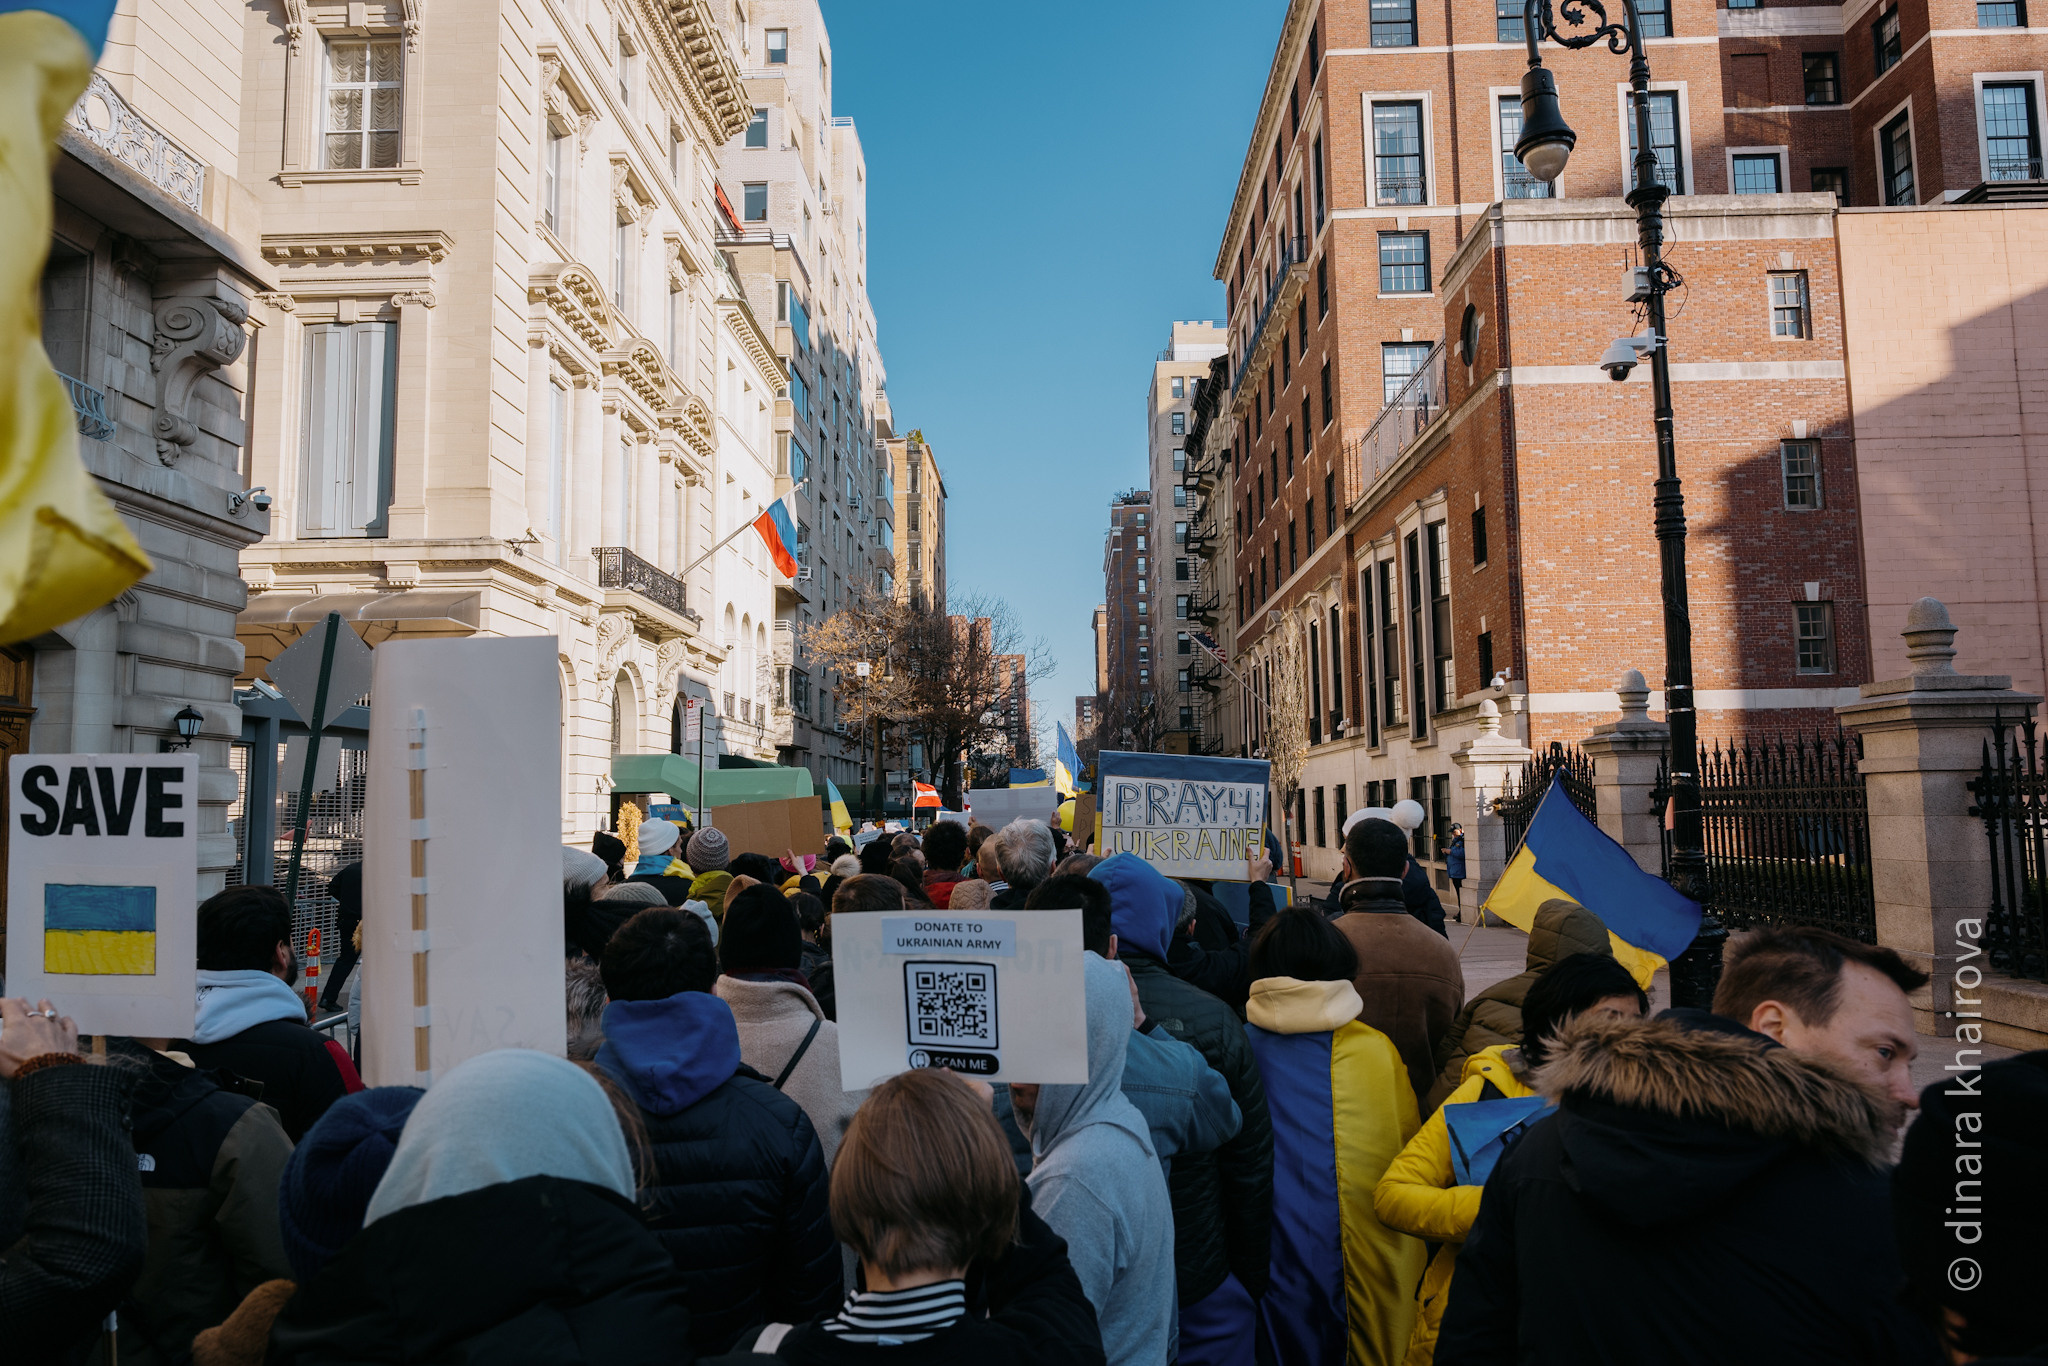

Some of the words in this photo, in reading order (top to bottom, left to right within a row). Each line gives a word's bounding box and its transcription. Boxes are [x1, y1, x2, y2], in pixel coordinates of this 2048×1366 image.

[20, 765, 185, 837] SAVE
[914, 922, 964, 933] DONATE
[967, 923, 983, 933] TO
[896, 937, 963, 948] UKRAINIAN
[967, 939, 1002, 950] ARMY
[935, 1056, 967, 1069] SCAN
[969, 1059, 988, 1071] ME
